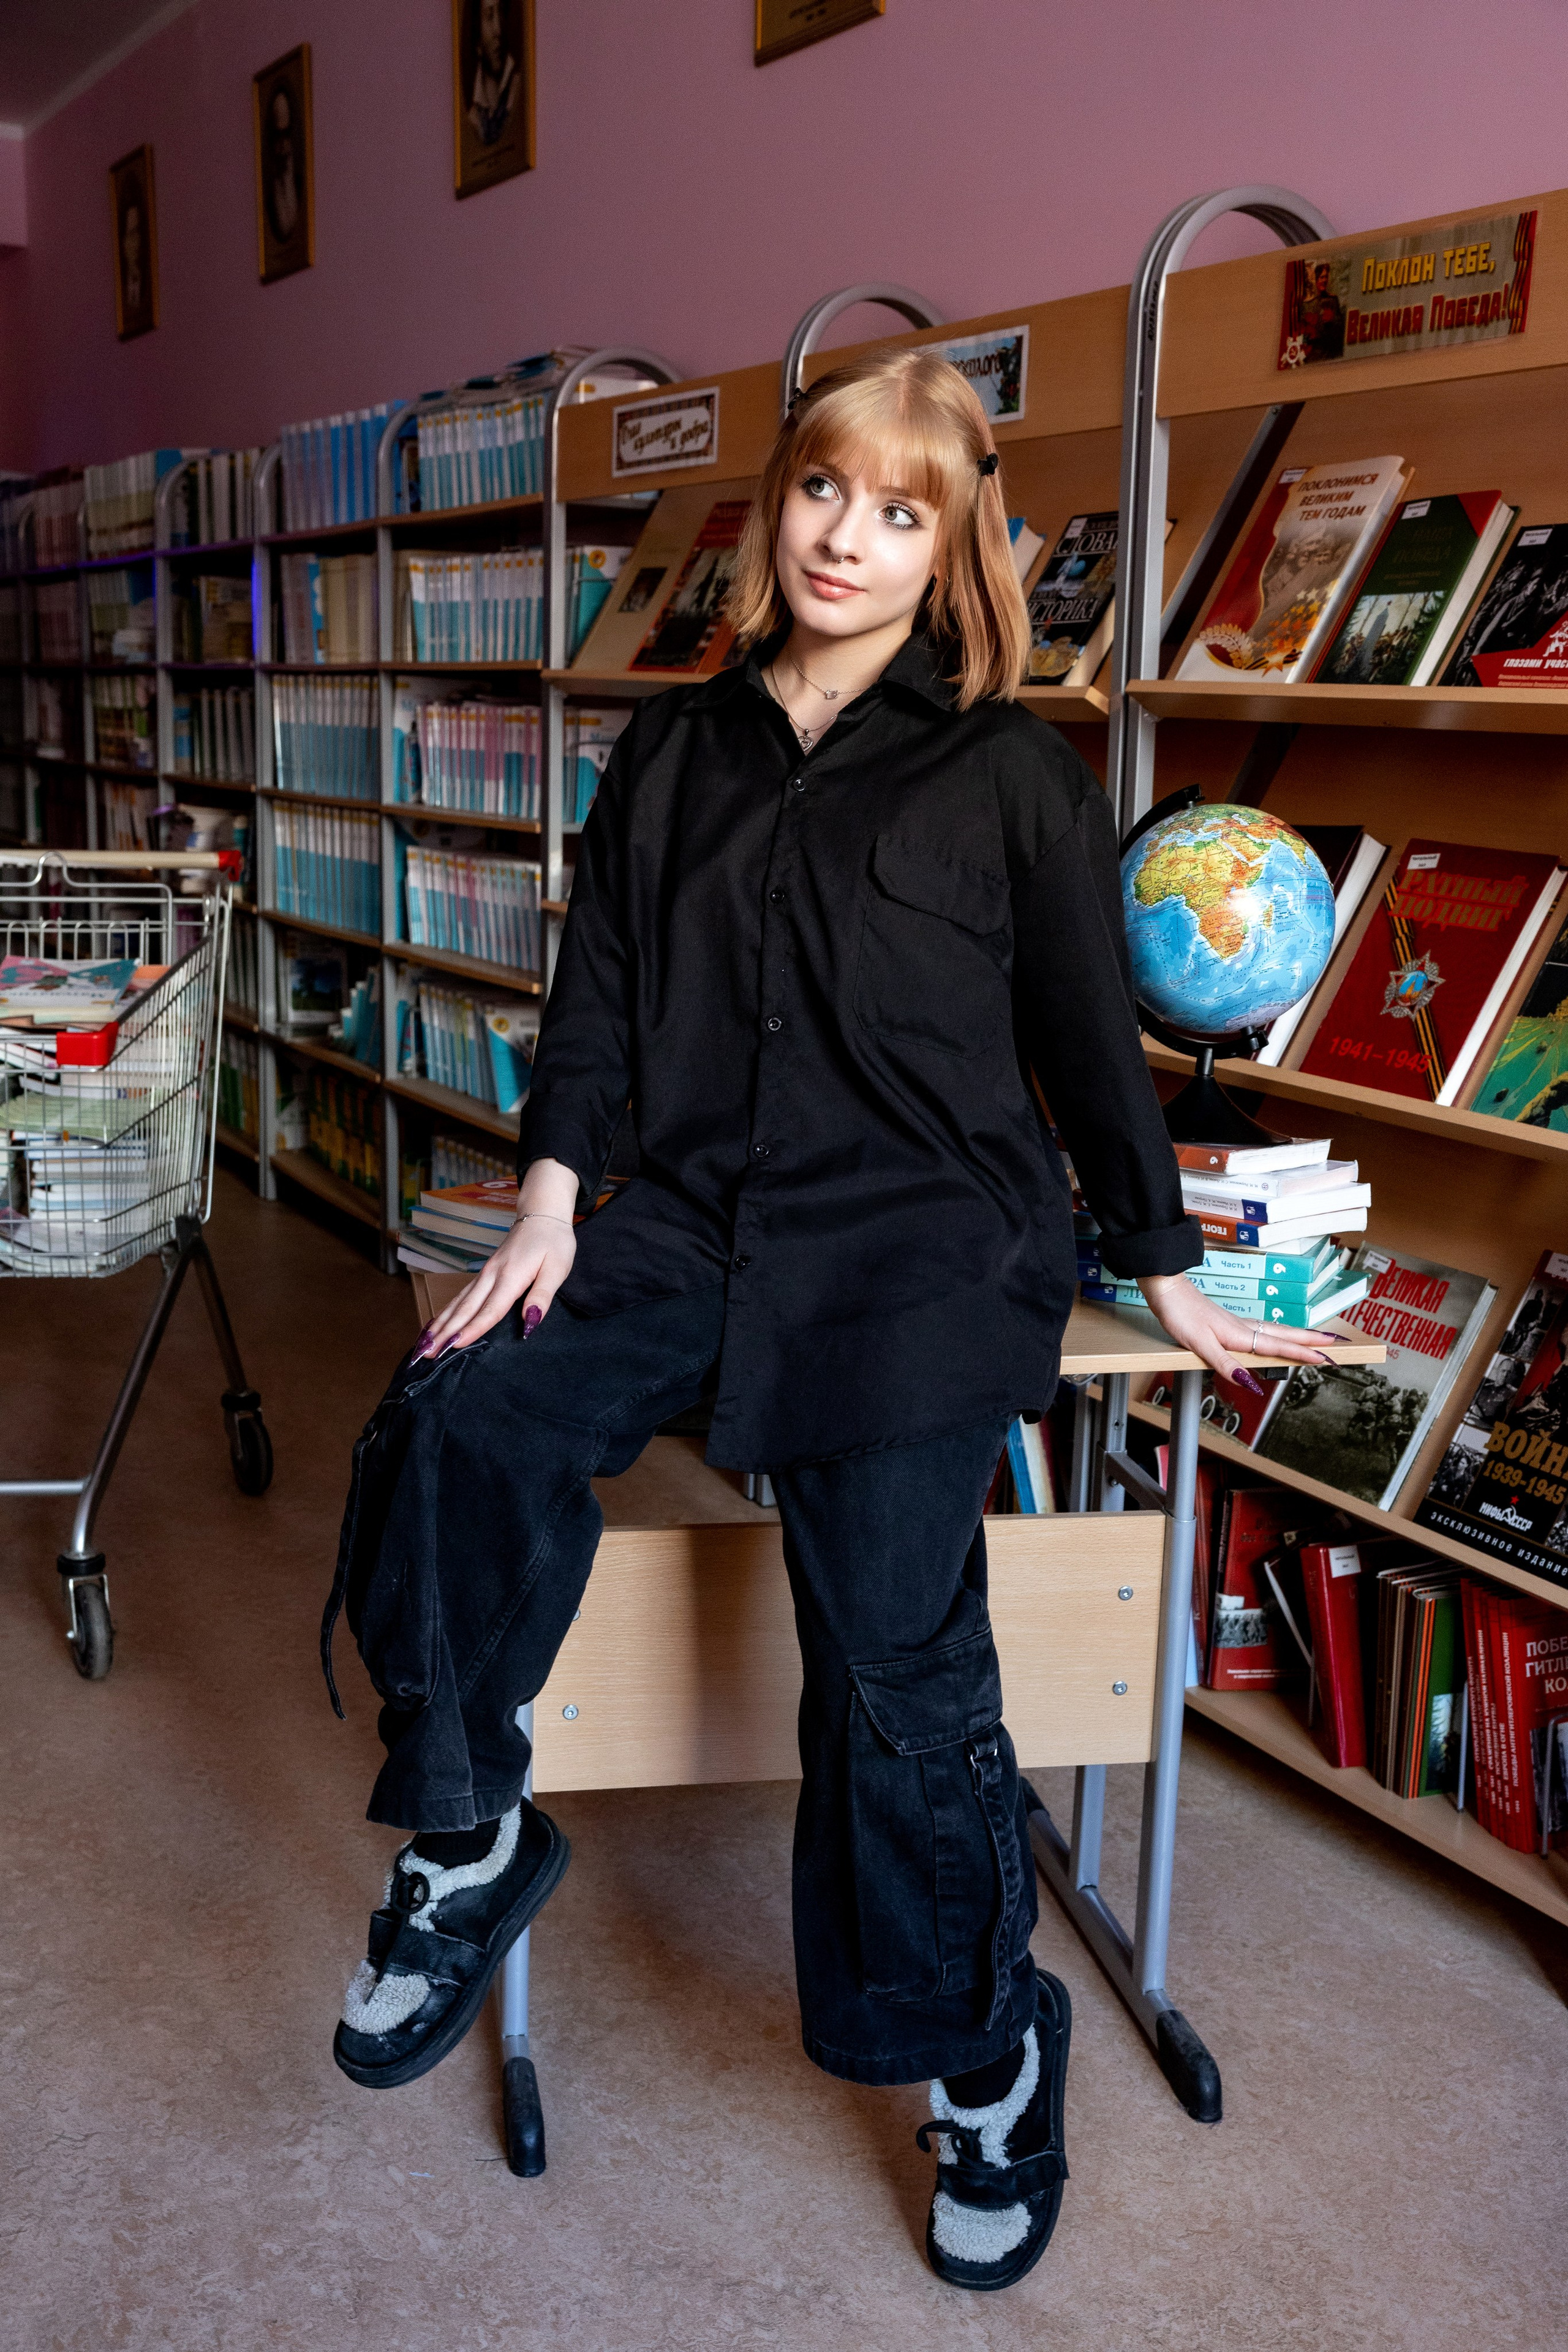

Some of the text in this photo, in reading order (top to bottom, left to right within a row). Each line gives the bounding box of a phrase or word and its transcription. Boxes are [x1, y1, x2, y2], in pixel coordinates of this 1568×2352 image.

[1362, 241, 1496, 294] ПОКЛОН ТЕБЕ,
[1346, 282, 1509, 345] ВЕЛИКАЯ ПОБЕДА!
[1297, 473, 1379, 492] ПОКЛОНИМСЯ
[1299, 491, 1354, 507] ВЕЛИКИМ
[1300, 505, 1366, 521] ТЕМ ГОДАМ
[1056, 532, 1118, 554] СЛОВА
[1397, 870, 1529, 907] РАТНЫЙ
[1388, 893, 1513, 931] ПОДВИГ
[1221, 1261, 1245, 1269] Часть
[1215, 1282, 1238, 1291] Часть
[1369, 1258, 1450, 1313] ВЕЛИКАЯ
[1223, 1303, 1245, 1312] Часть
[1483, 1420, 1568, 1480] ВОЙН
[1483, 1460, 1567, 1505] 1939-1945
